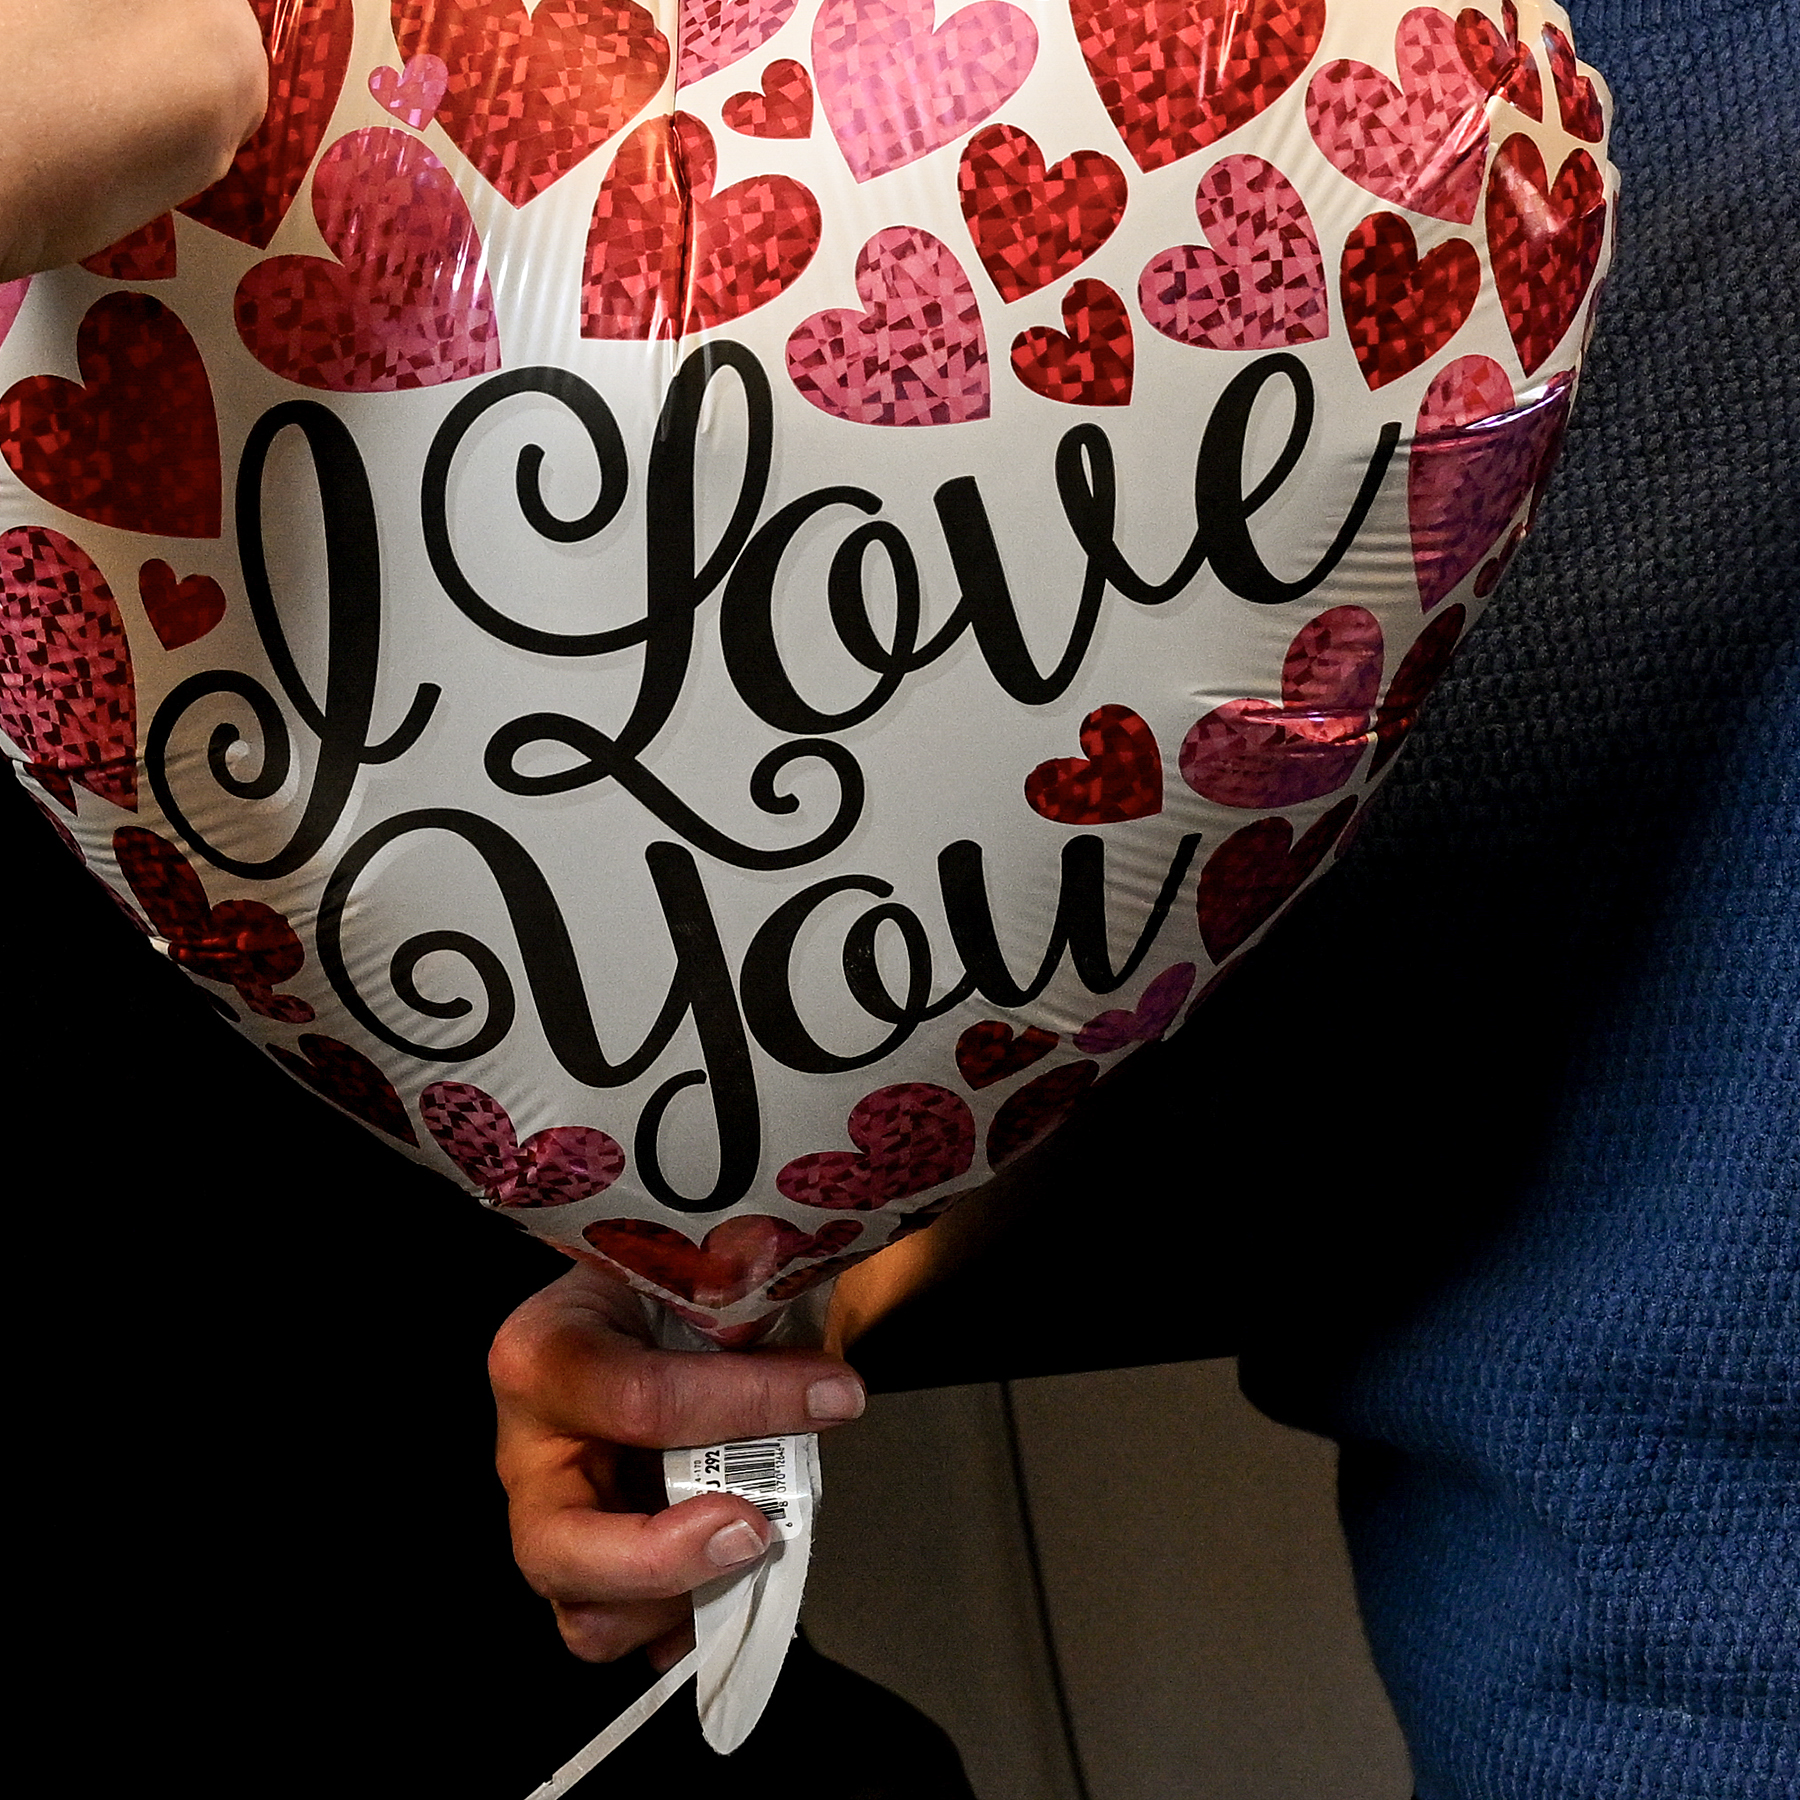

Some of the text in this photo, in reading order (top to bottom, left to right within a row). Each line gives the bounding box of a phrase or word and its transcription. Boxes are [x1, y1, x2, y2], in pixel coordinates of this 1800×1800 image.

[145, 340, 1401, 880] I Love
[316, 808, 1201, 1213] You
[704, 1450, 720, 1474] 292
